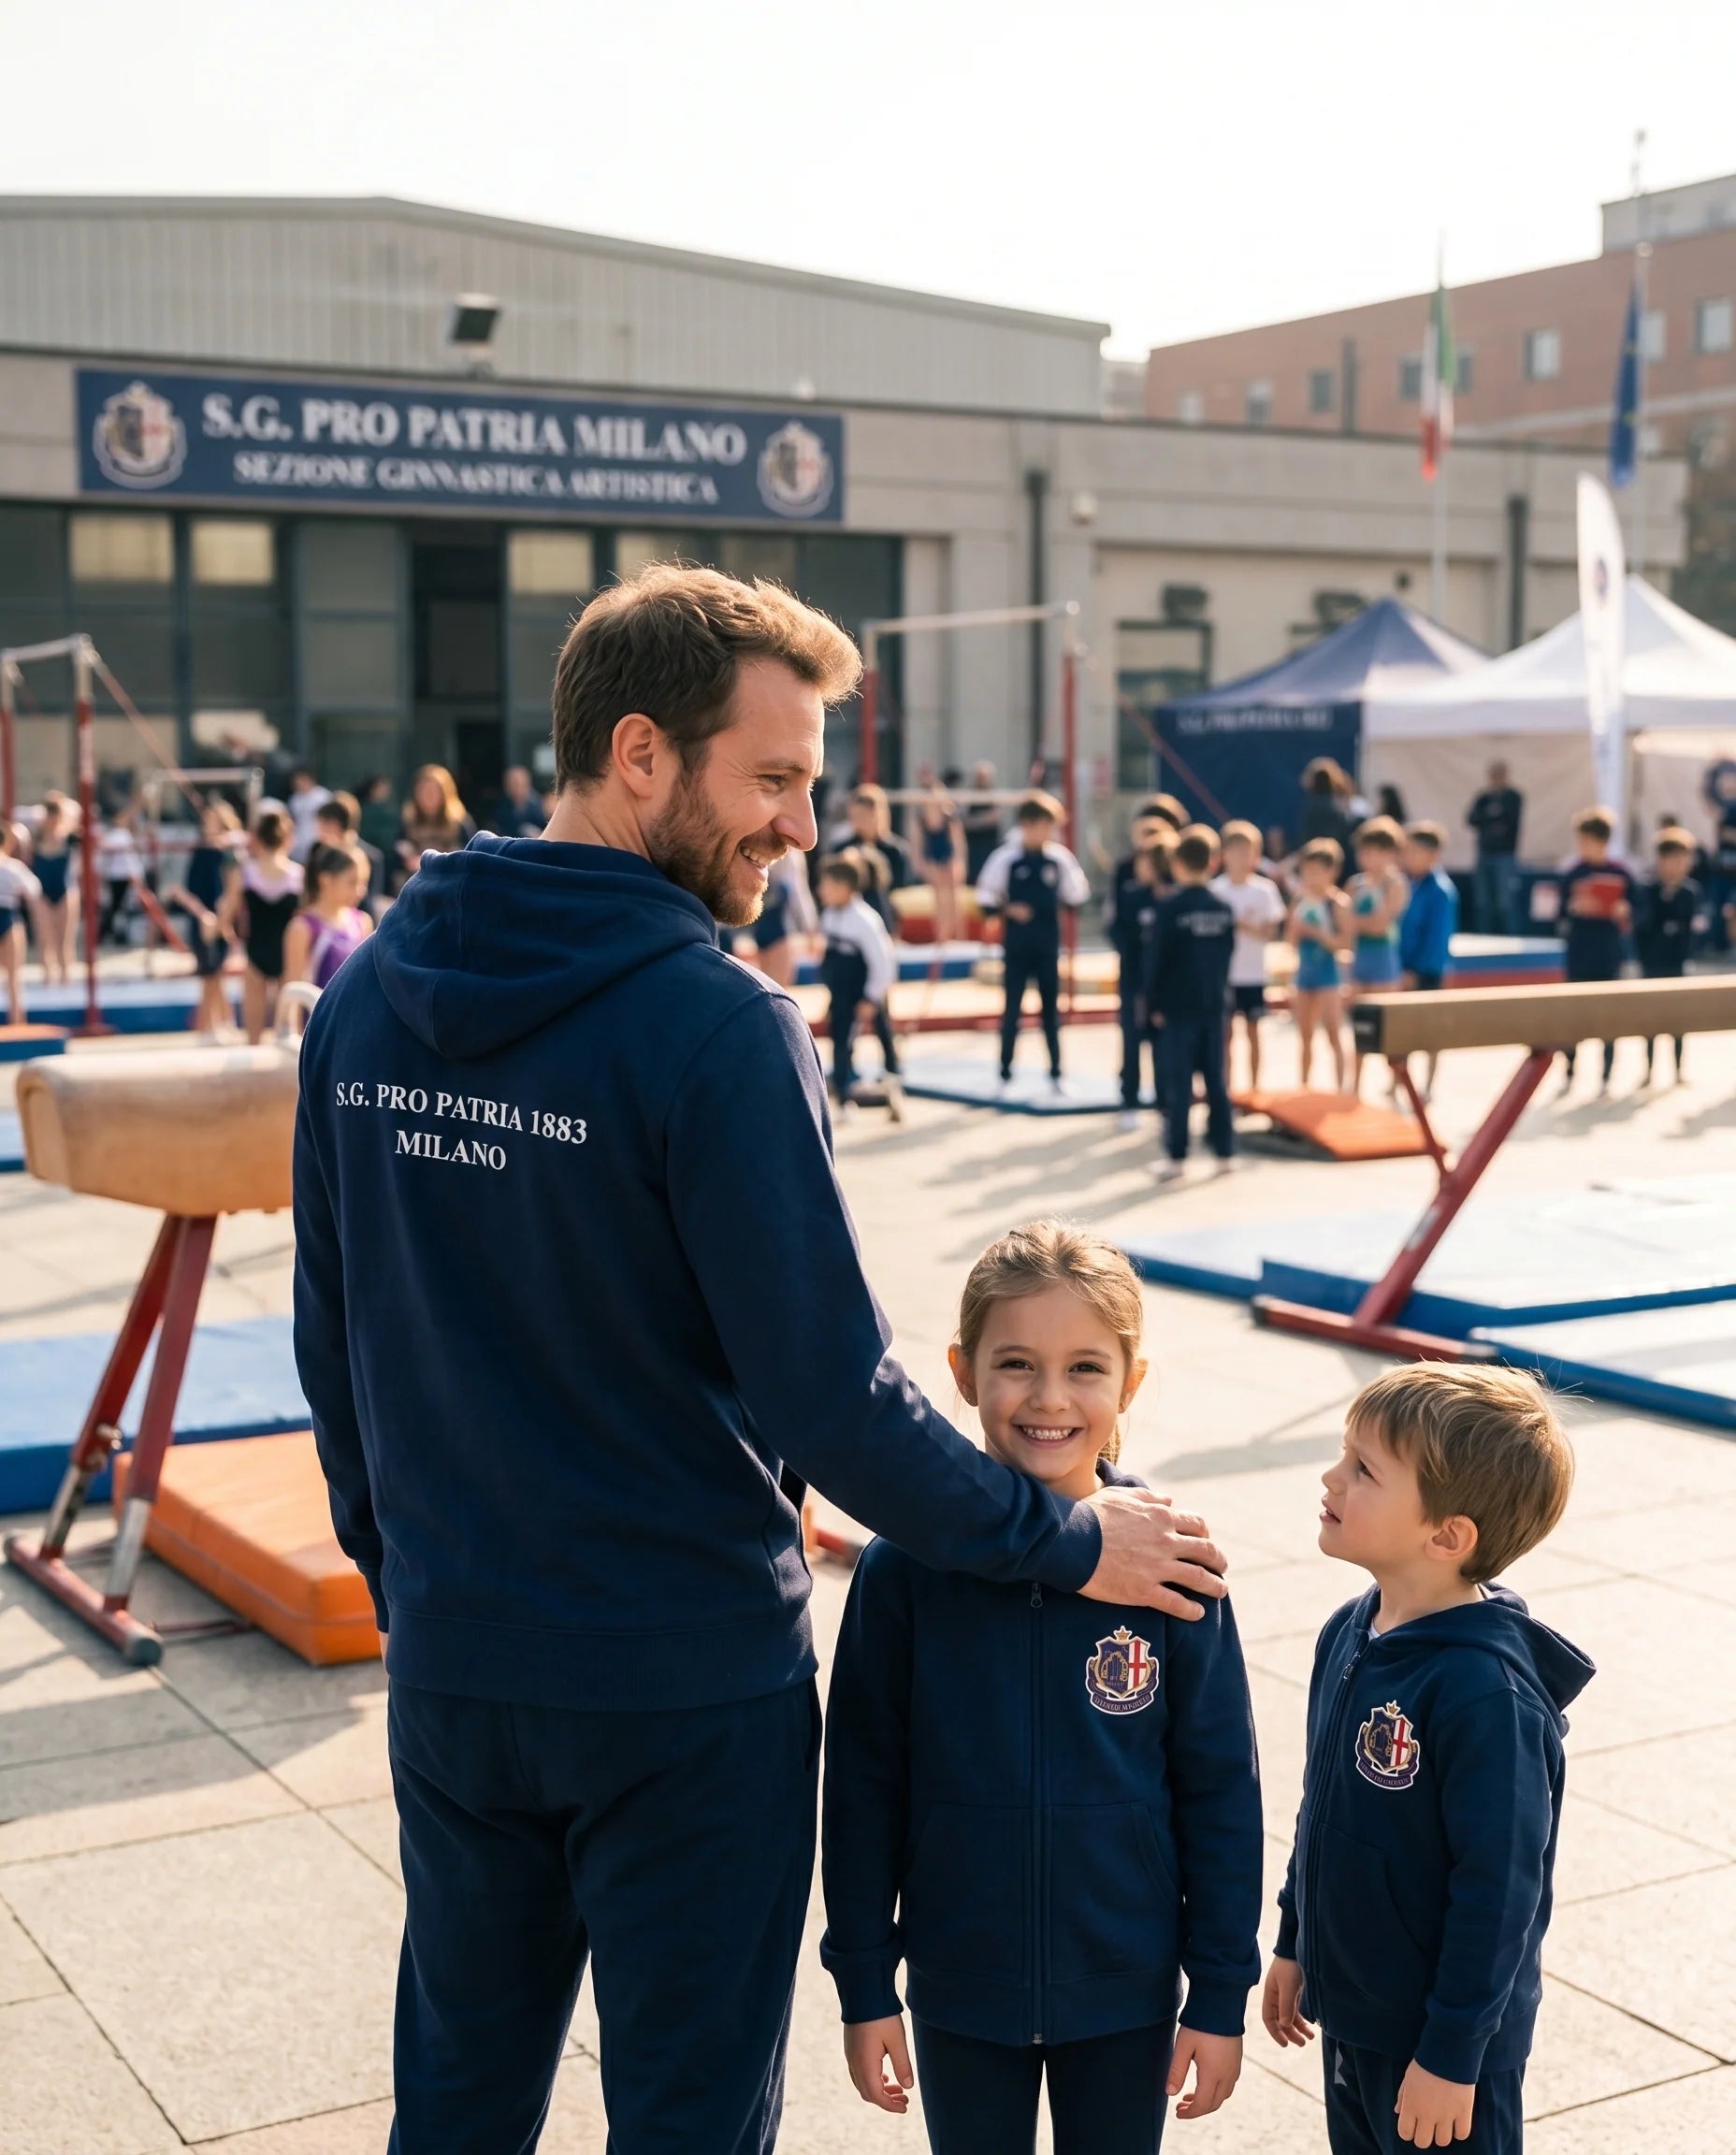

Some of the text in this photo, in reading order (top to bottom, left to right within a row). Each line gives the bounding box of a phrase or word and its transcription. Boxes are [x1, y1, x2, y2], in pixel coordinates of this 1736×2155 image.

[202, 392, 747, 465] S.G. PRO PATRIA MILANO
[234, 450, 372, 487] SEZIONE
[567, 468, 719, 505] ARTISTICA
[336, 1081, 587, 1145] S.G. PRO PATRIA 1883
[394, 1129, 507, 1171] MILANO
